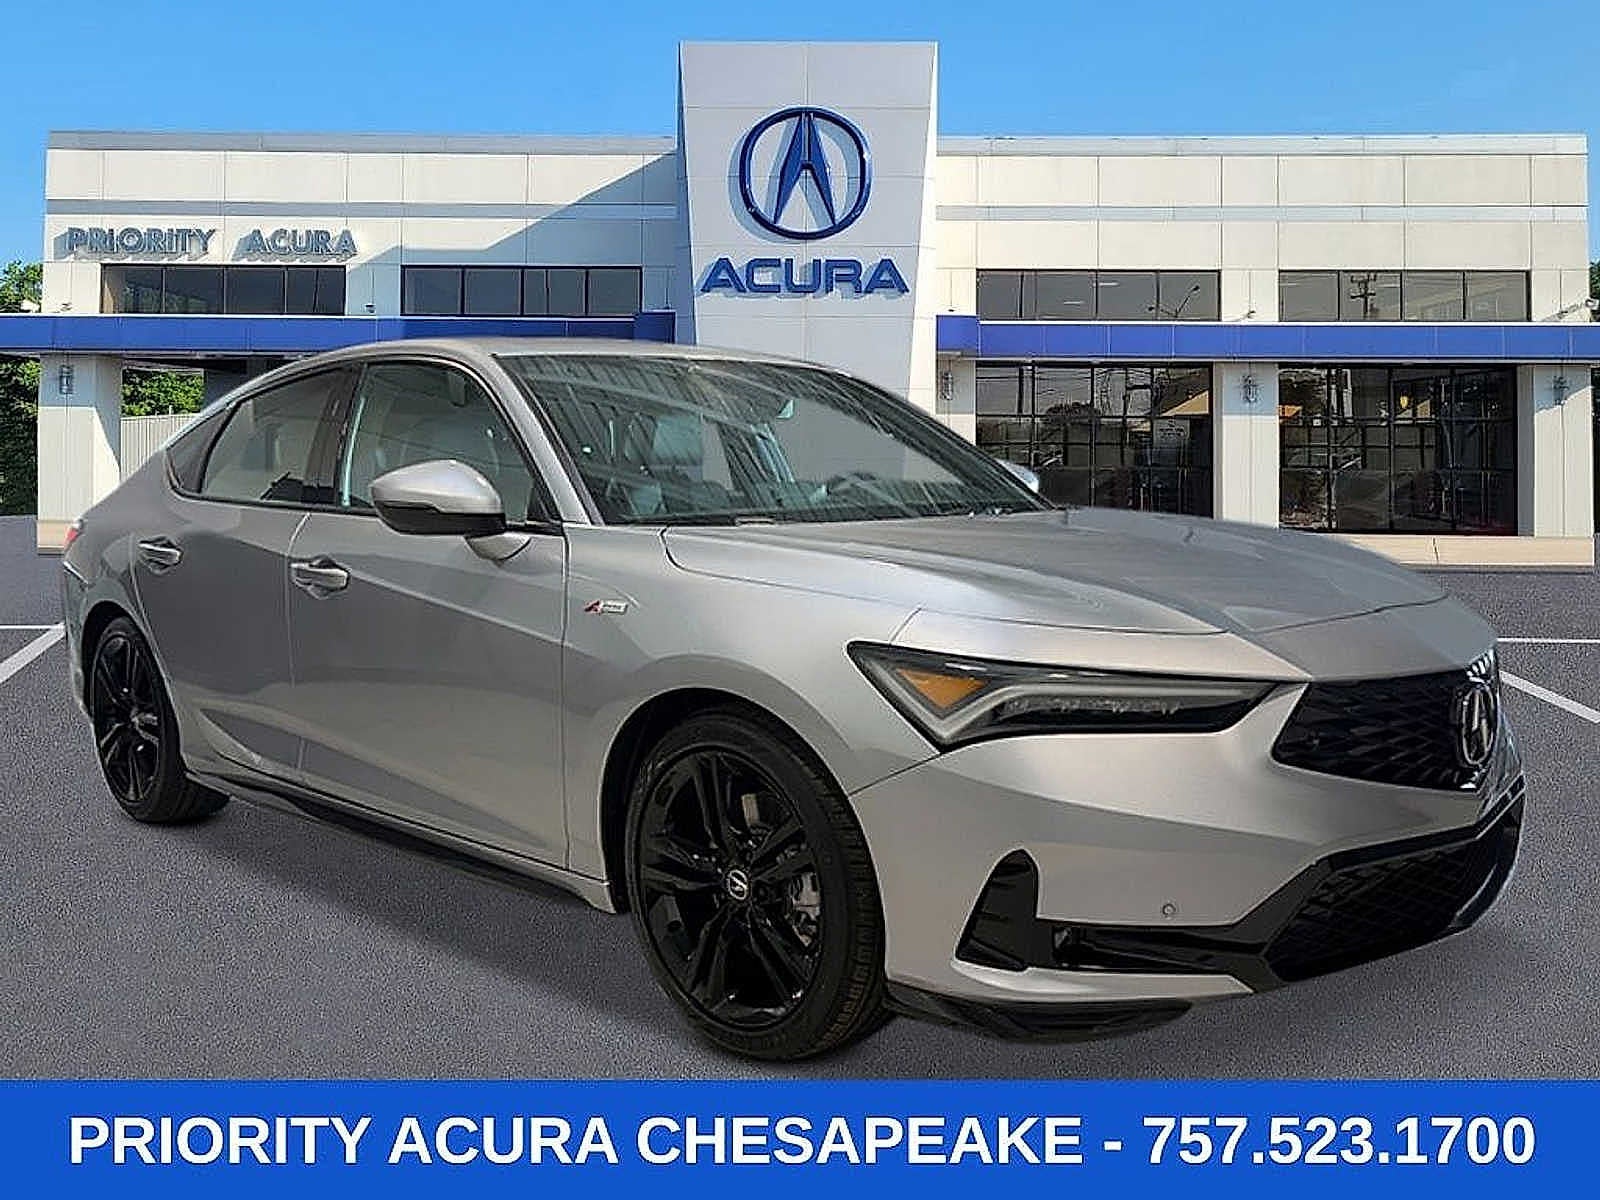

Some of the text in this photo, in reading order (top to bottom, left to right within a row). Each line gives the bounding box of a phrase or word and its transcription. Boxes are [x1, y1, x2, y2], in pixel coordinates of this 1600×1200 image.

[66, 227, 358, 256] PRIORITY ACURA
[700, 256, 911, 295] ACURA
